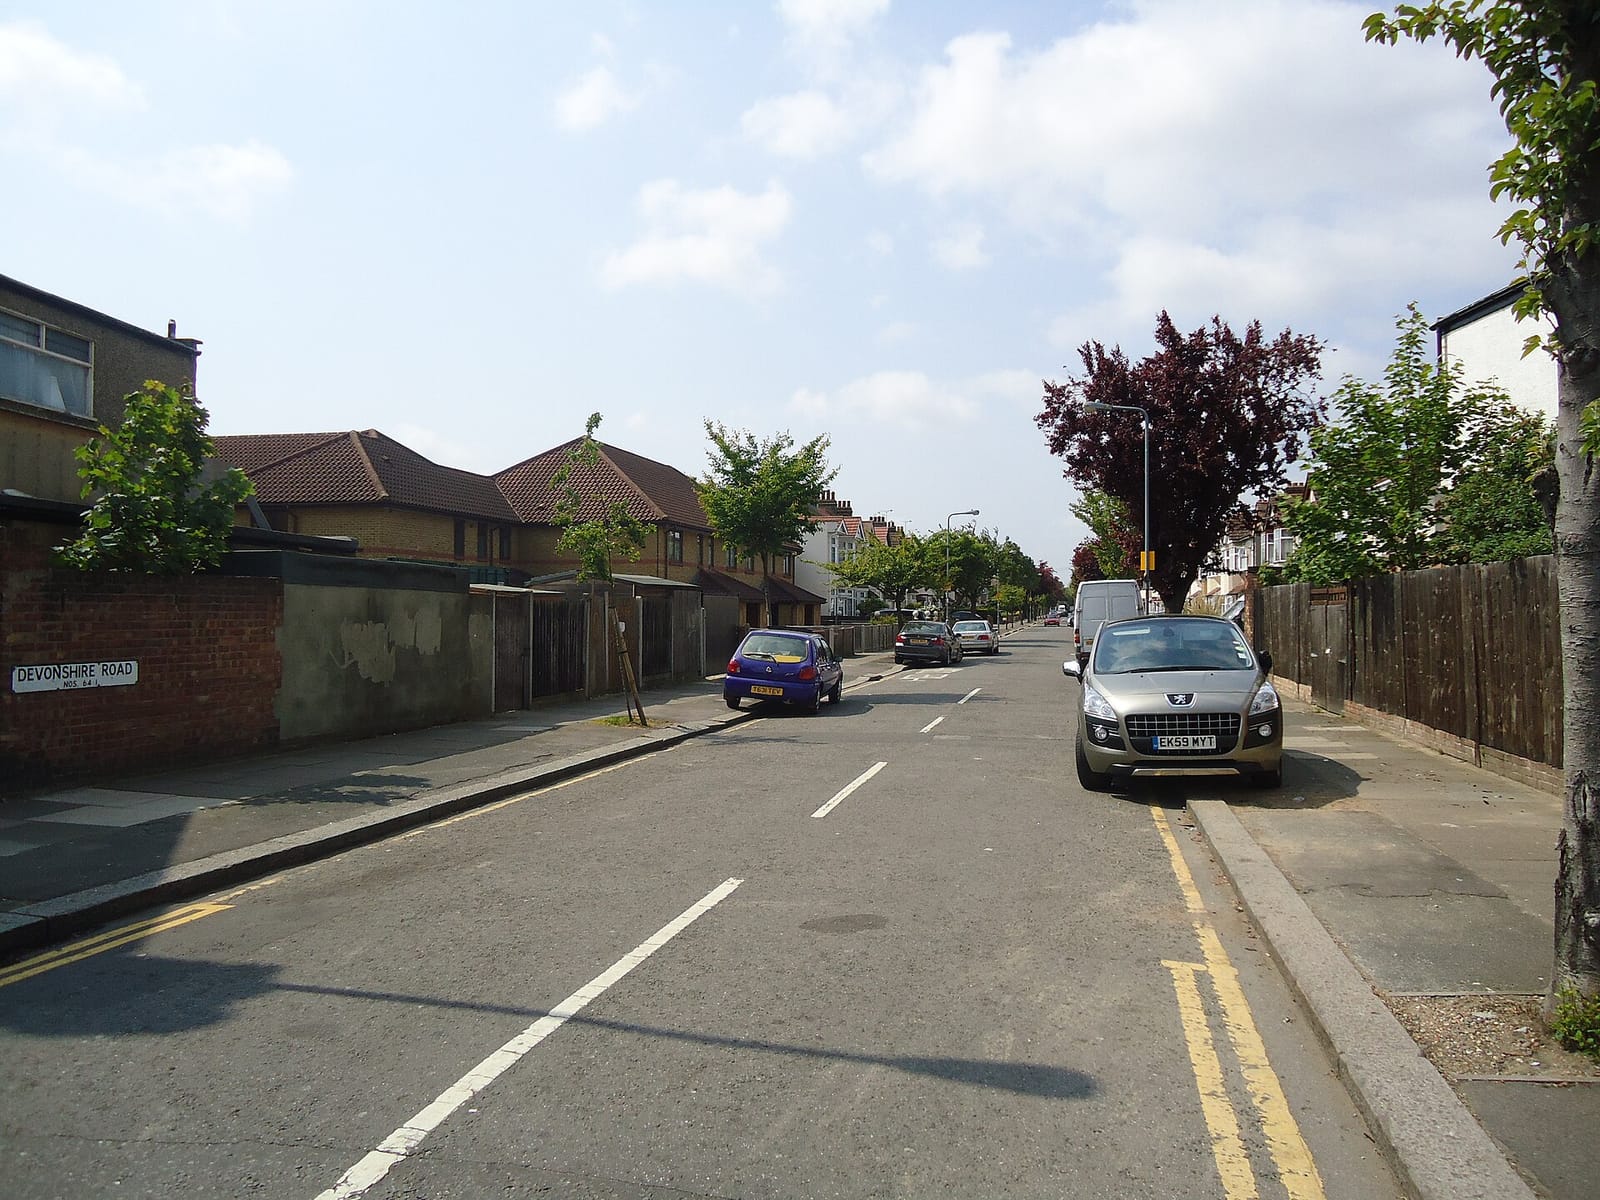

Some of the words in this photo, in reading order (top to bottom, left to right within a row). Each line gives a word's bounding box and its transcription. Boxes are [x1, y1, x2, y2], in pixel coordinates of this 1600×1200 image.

[17, 664, 96, 682] DEVONSHIRE
[101, 662, 133, 677] ROAD
[1160, 737, 1189, 747] EK59
[1192, 736, 1214, 747] MYT
